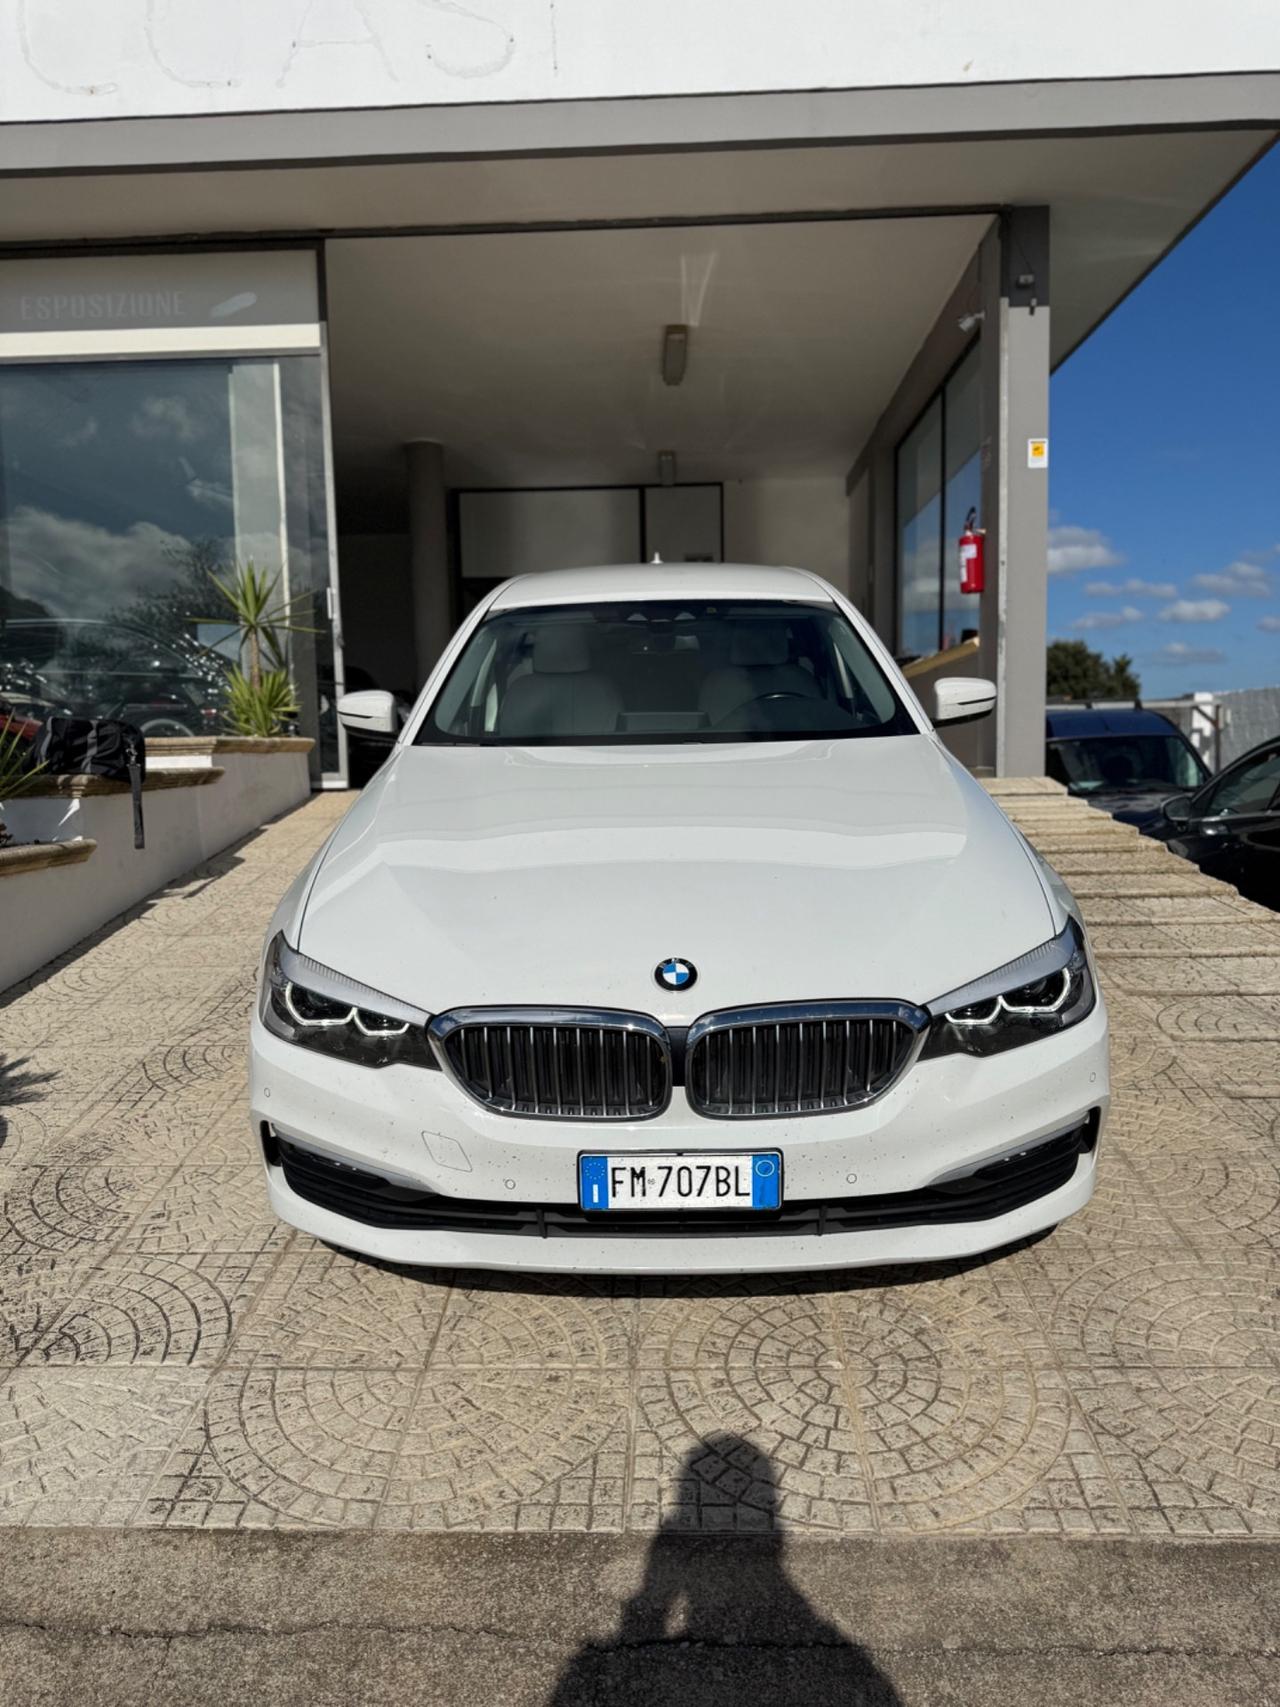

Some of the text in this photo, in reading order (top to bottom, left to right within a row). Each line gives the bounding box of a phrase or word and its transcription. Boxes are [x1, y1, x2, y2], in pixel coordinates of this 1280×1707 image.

[20, 290, 185, 321] ESPOSIZIONE
[611, 1165, 750, 1198] FM 707BL
